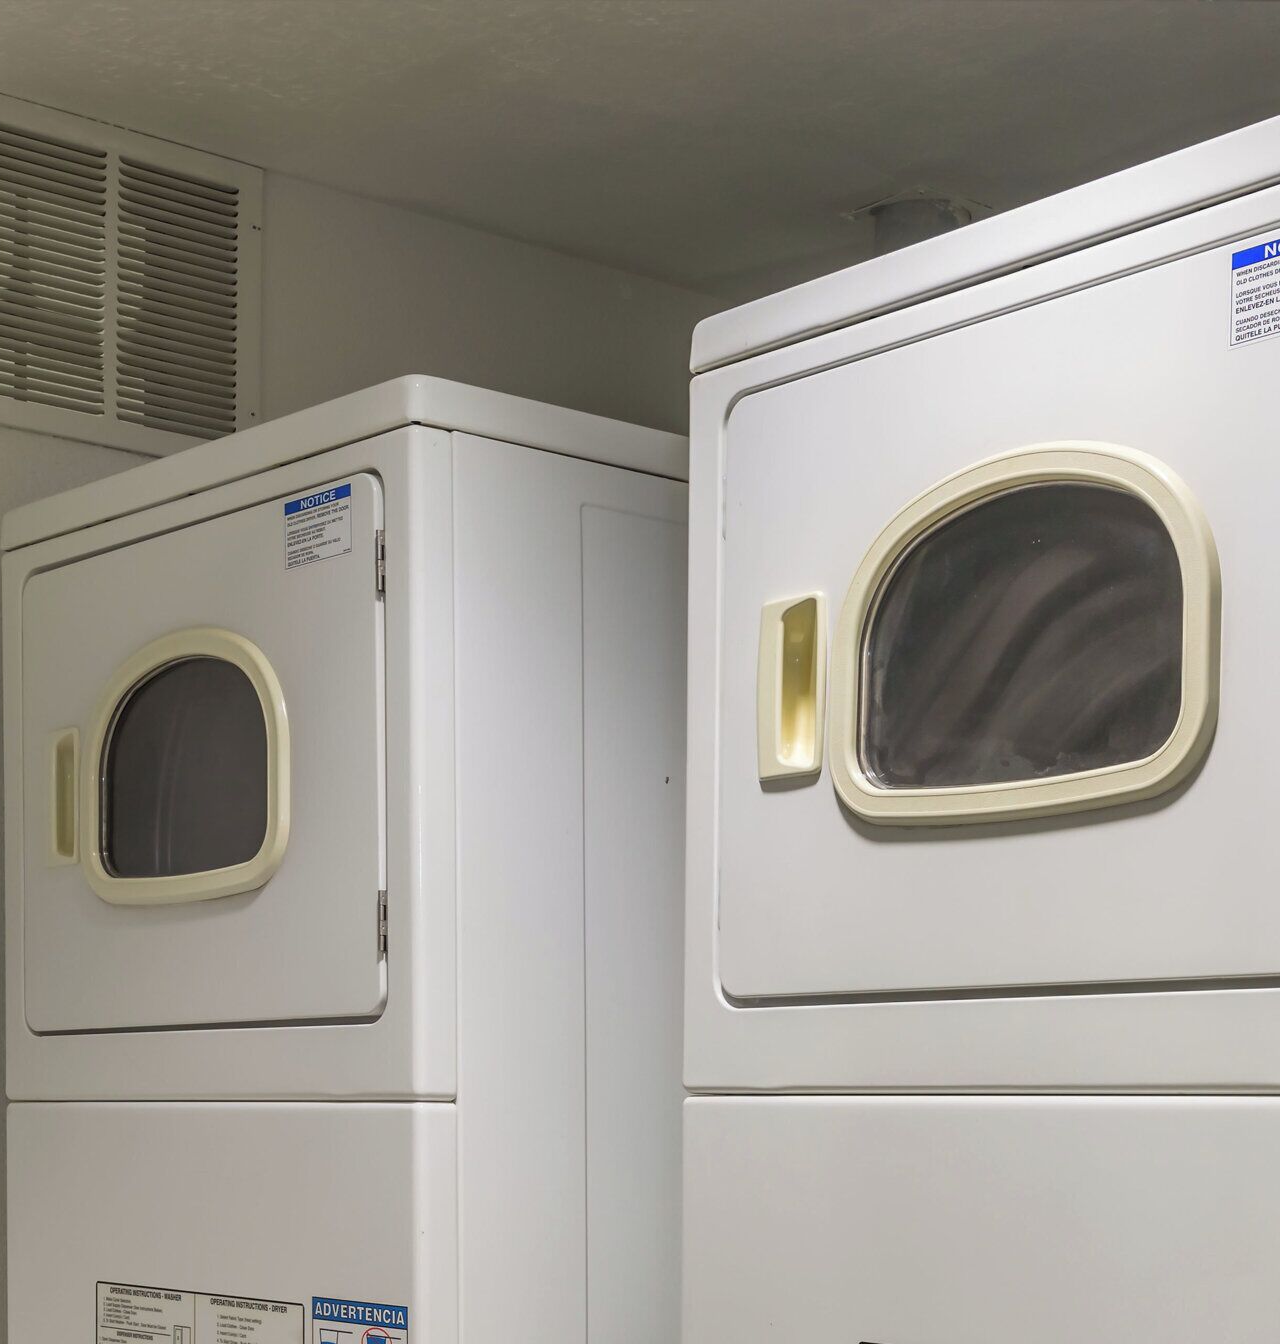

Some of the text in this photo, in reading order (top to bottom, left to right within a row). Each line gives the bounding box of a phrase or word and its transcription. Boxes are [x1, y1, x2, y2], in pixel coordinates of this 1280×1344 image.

[1236, 268, 1253, 278] WHEN
[1236, 276, 1248, 286] OLD
[1248, 269, 1274, 282] CLOTHES
[1235, 285, 1261, 299] LORSQUE
[1262, 280, 1278, 291] VOUS
[1235, 295, 1254, 306] VOTRE
[1235, 297, 1275, 315] ENLEVEZ-EN
[1235, 314, 1259, 326] CUANDO
[1235, 321, 1262, 334] SECADOR
[1235, 328, 1262, 342] QUITELE
[1263, 325, 1272, 334] LA
[300, 490, 336, 510] NOTICE
[109, 1286, 132, 1296] OPERATING
[133, 1289, 161, 1300] INSTRUCTIONS
[163, 1292, 182, 1302] WASHER
[210, 1298, 235, 1308] OPERATING
[235, 1300, 268, 1312] INSTRUCTIONS
[271, 1304, 288, 1314] DRYER
[315, 1302, 405, 1325] ADVERTENCIA
